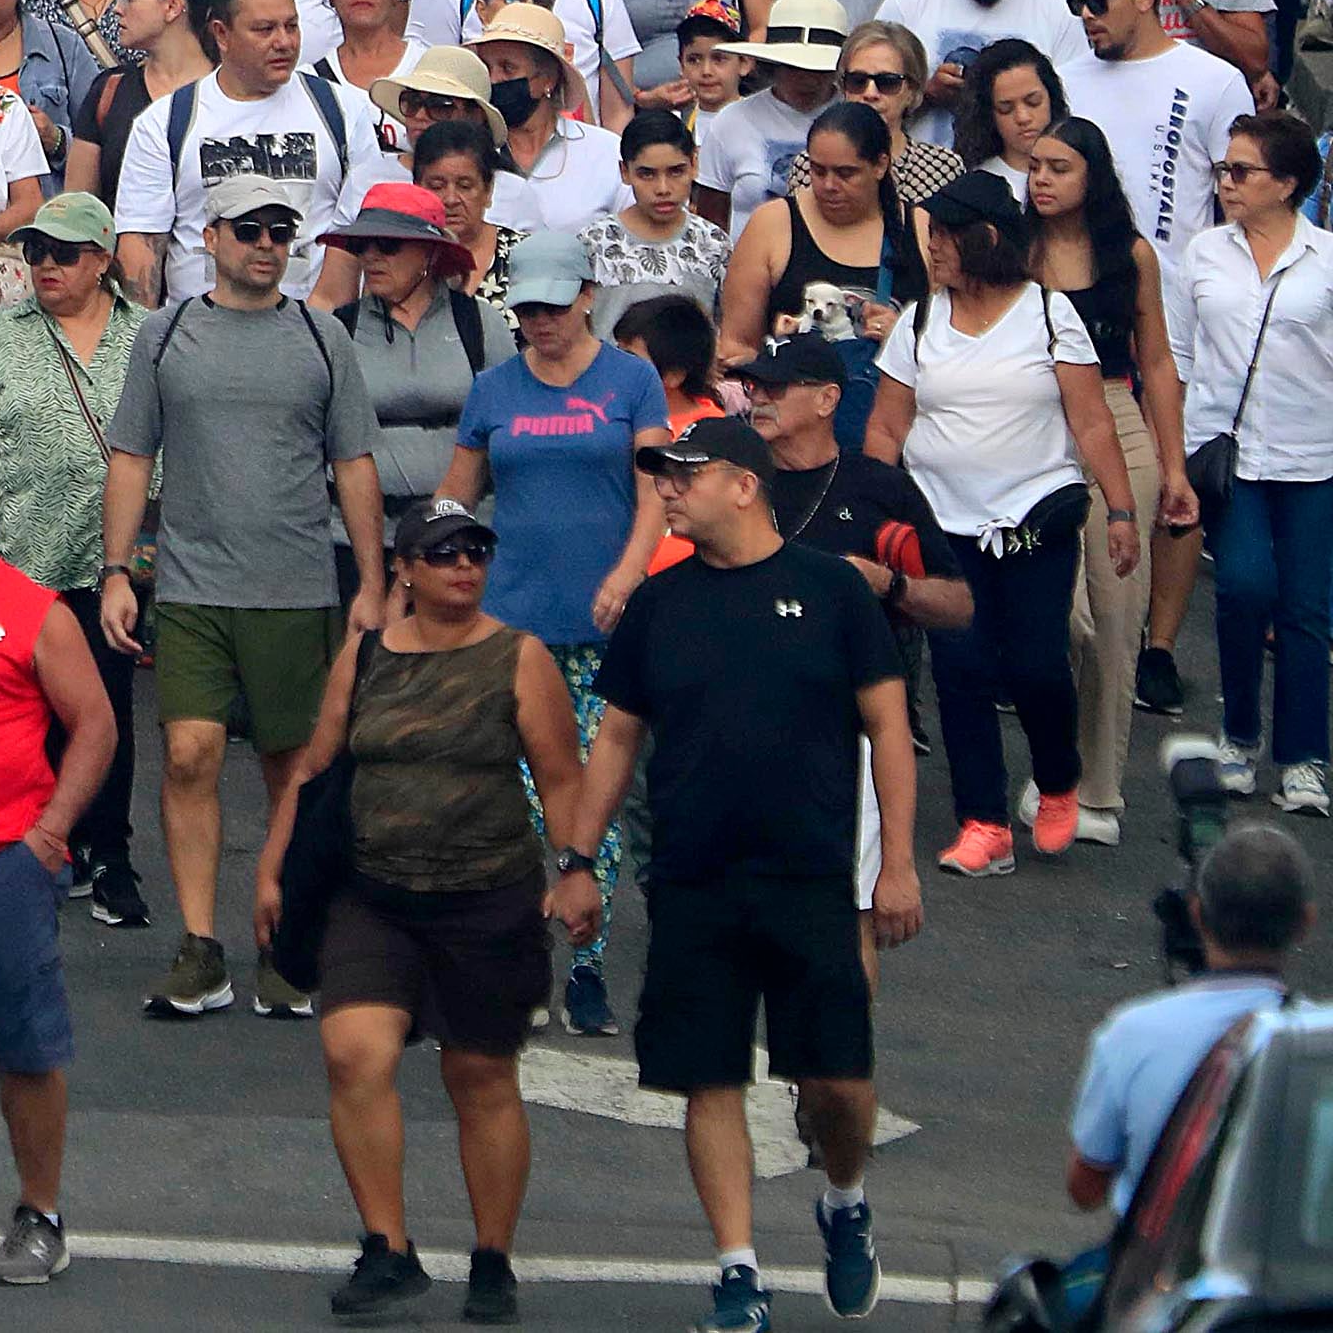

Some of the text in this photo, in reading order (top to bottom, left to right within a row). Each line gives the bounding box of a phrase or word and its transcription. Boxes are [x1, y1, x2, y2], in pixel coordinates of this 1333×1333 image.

[1155, 88, 1190, 243] AEROPOSTALE
[512, 414, 594, 437] PUMA
[839, 507, 853, 521] ck
